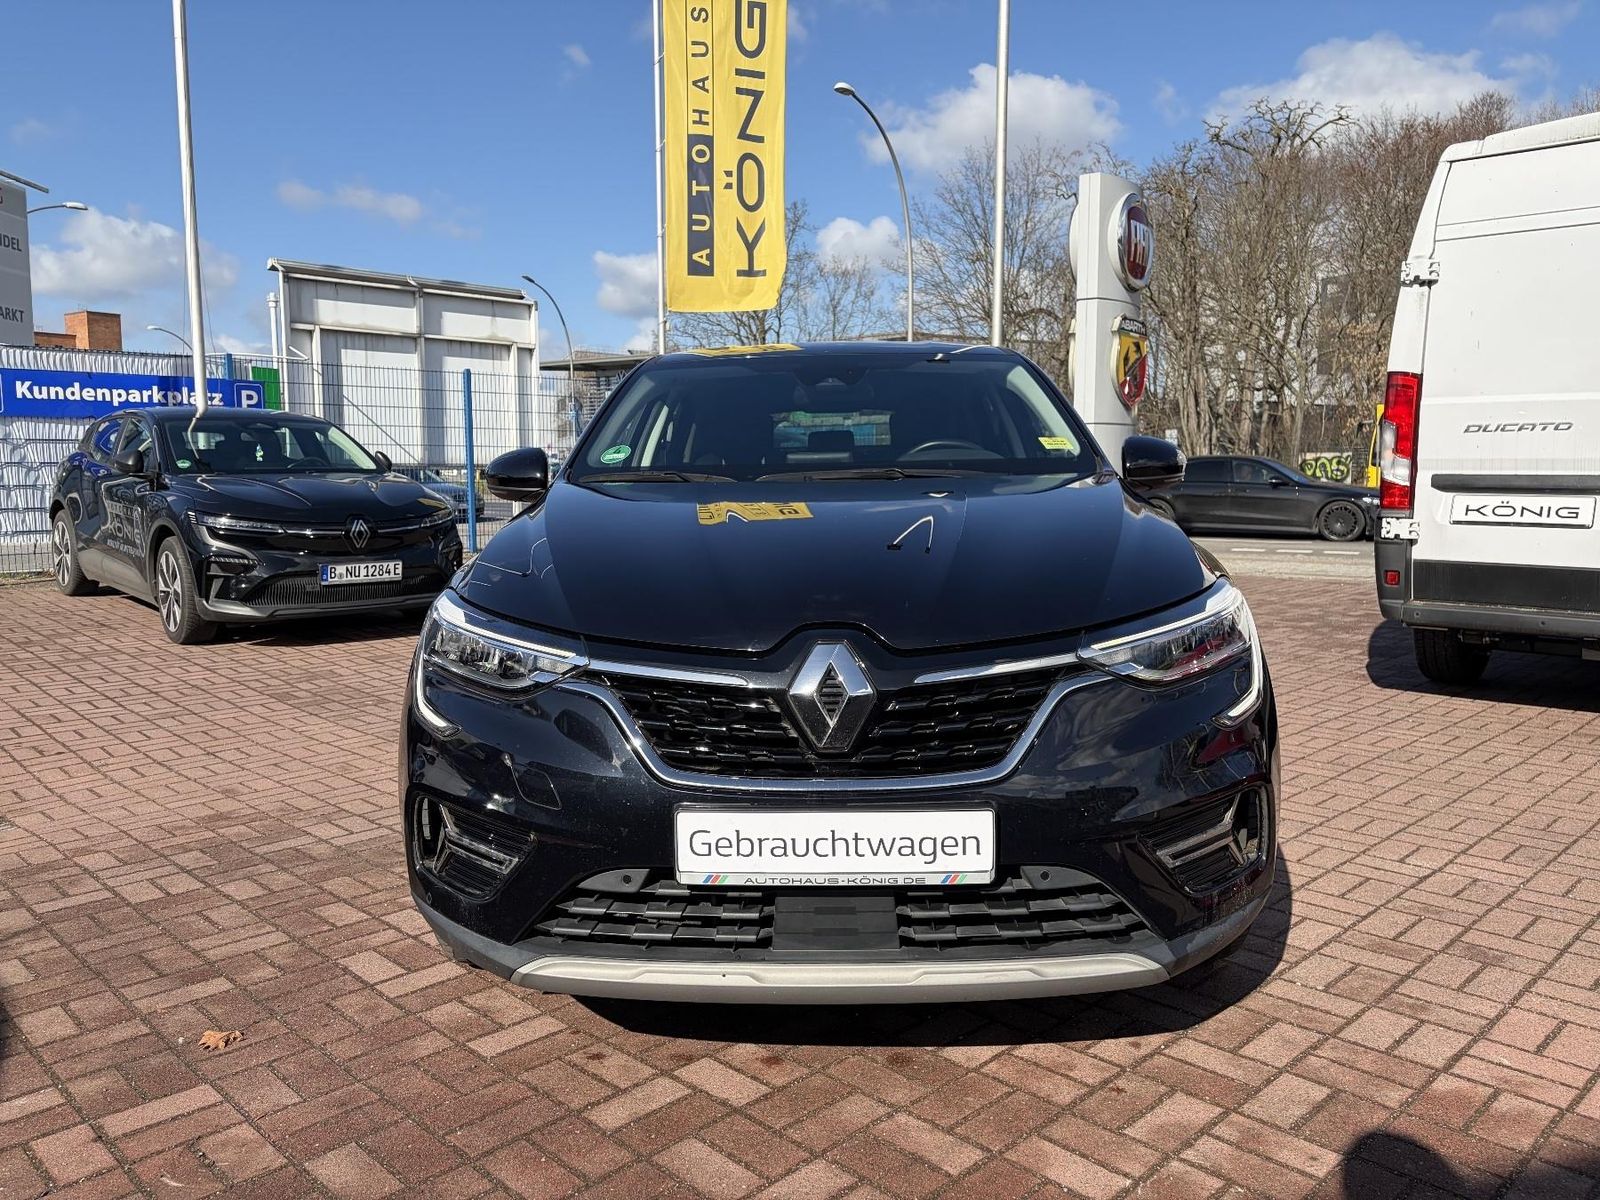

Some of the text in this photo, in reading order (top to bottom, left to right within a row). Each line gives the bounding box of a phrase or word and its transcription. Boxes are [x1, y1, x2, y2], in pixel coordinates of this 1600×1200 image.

[691, 6, 711, 267] AUTOHAUS
[722, 0, 767, 278] KÖNIG
[241, 390, 259, 409] P
[1463, 421, 1574, 434] DUCATO
[1465, 500, 1581, 520] KÖNIG
[330, 566, 337, 580] B
[345, 565, 361, 579] NU
[689, 829, 982, 865] Gebrauchtwagen
